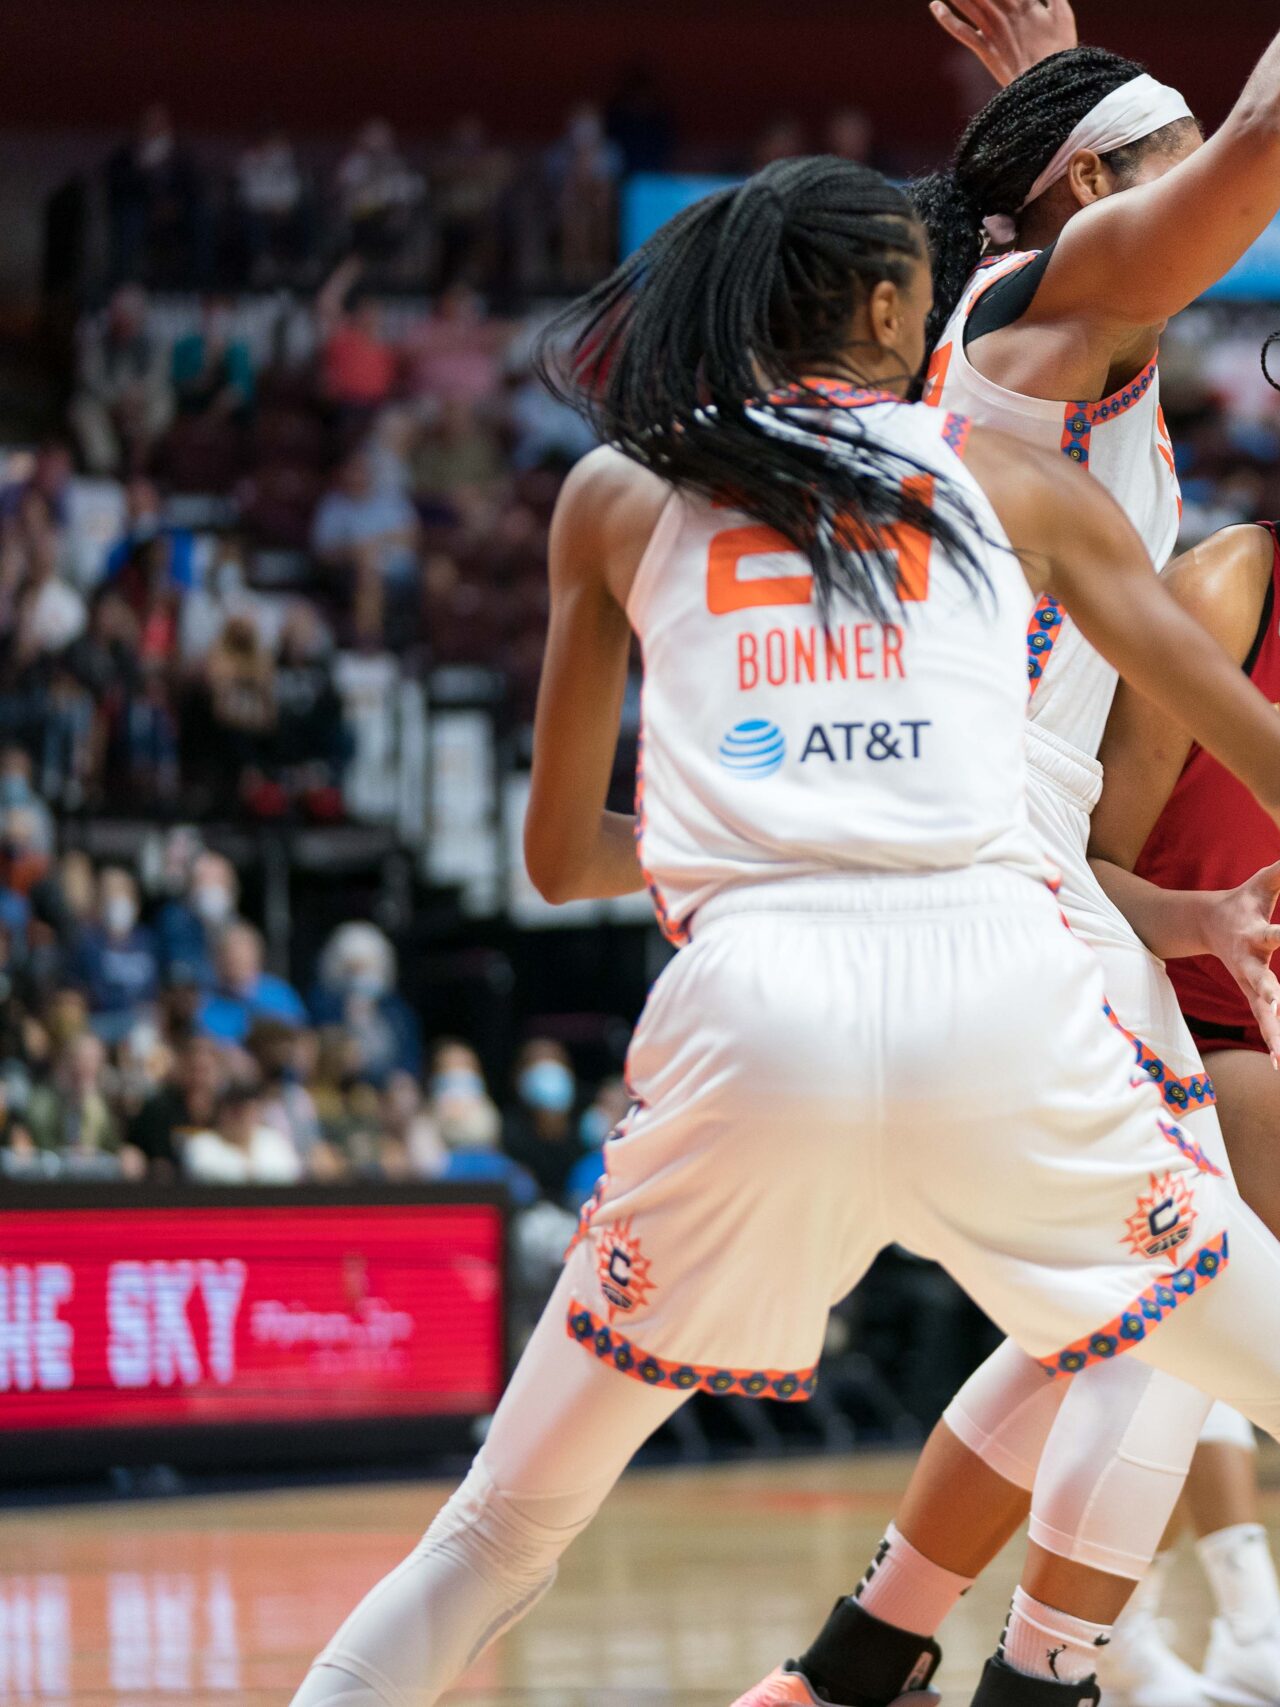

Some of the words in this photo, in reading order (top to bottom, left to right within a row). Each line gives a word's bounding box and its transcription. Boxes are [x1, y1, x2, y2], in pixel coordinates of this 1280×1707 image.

[737, 623, 906, 691] BONNER
[800, 720, 931, 764] AT&T
[106, 1258, 248, 1388] SKY
